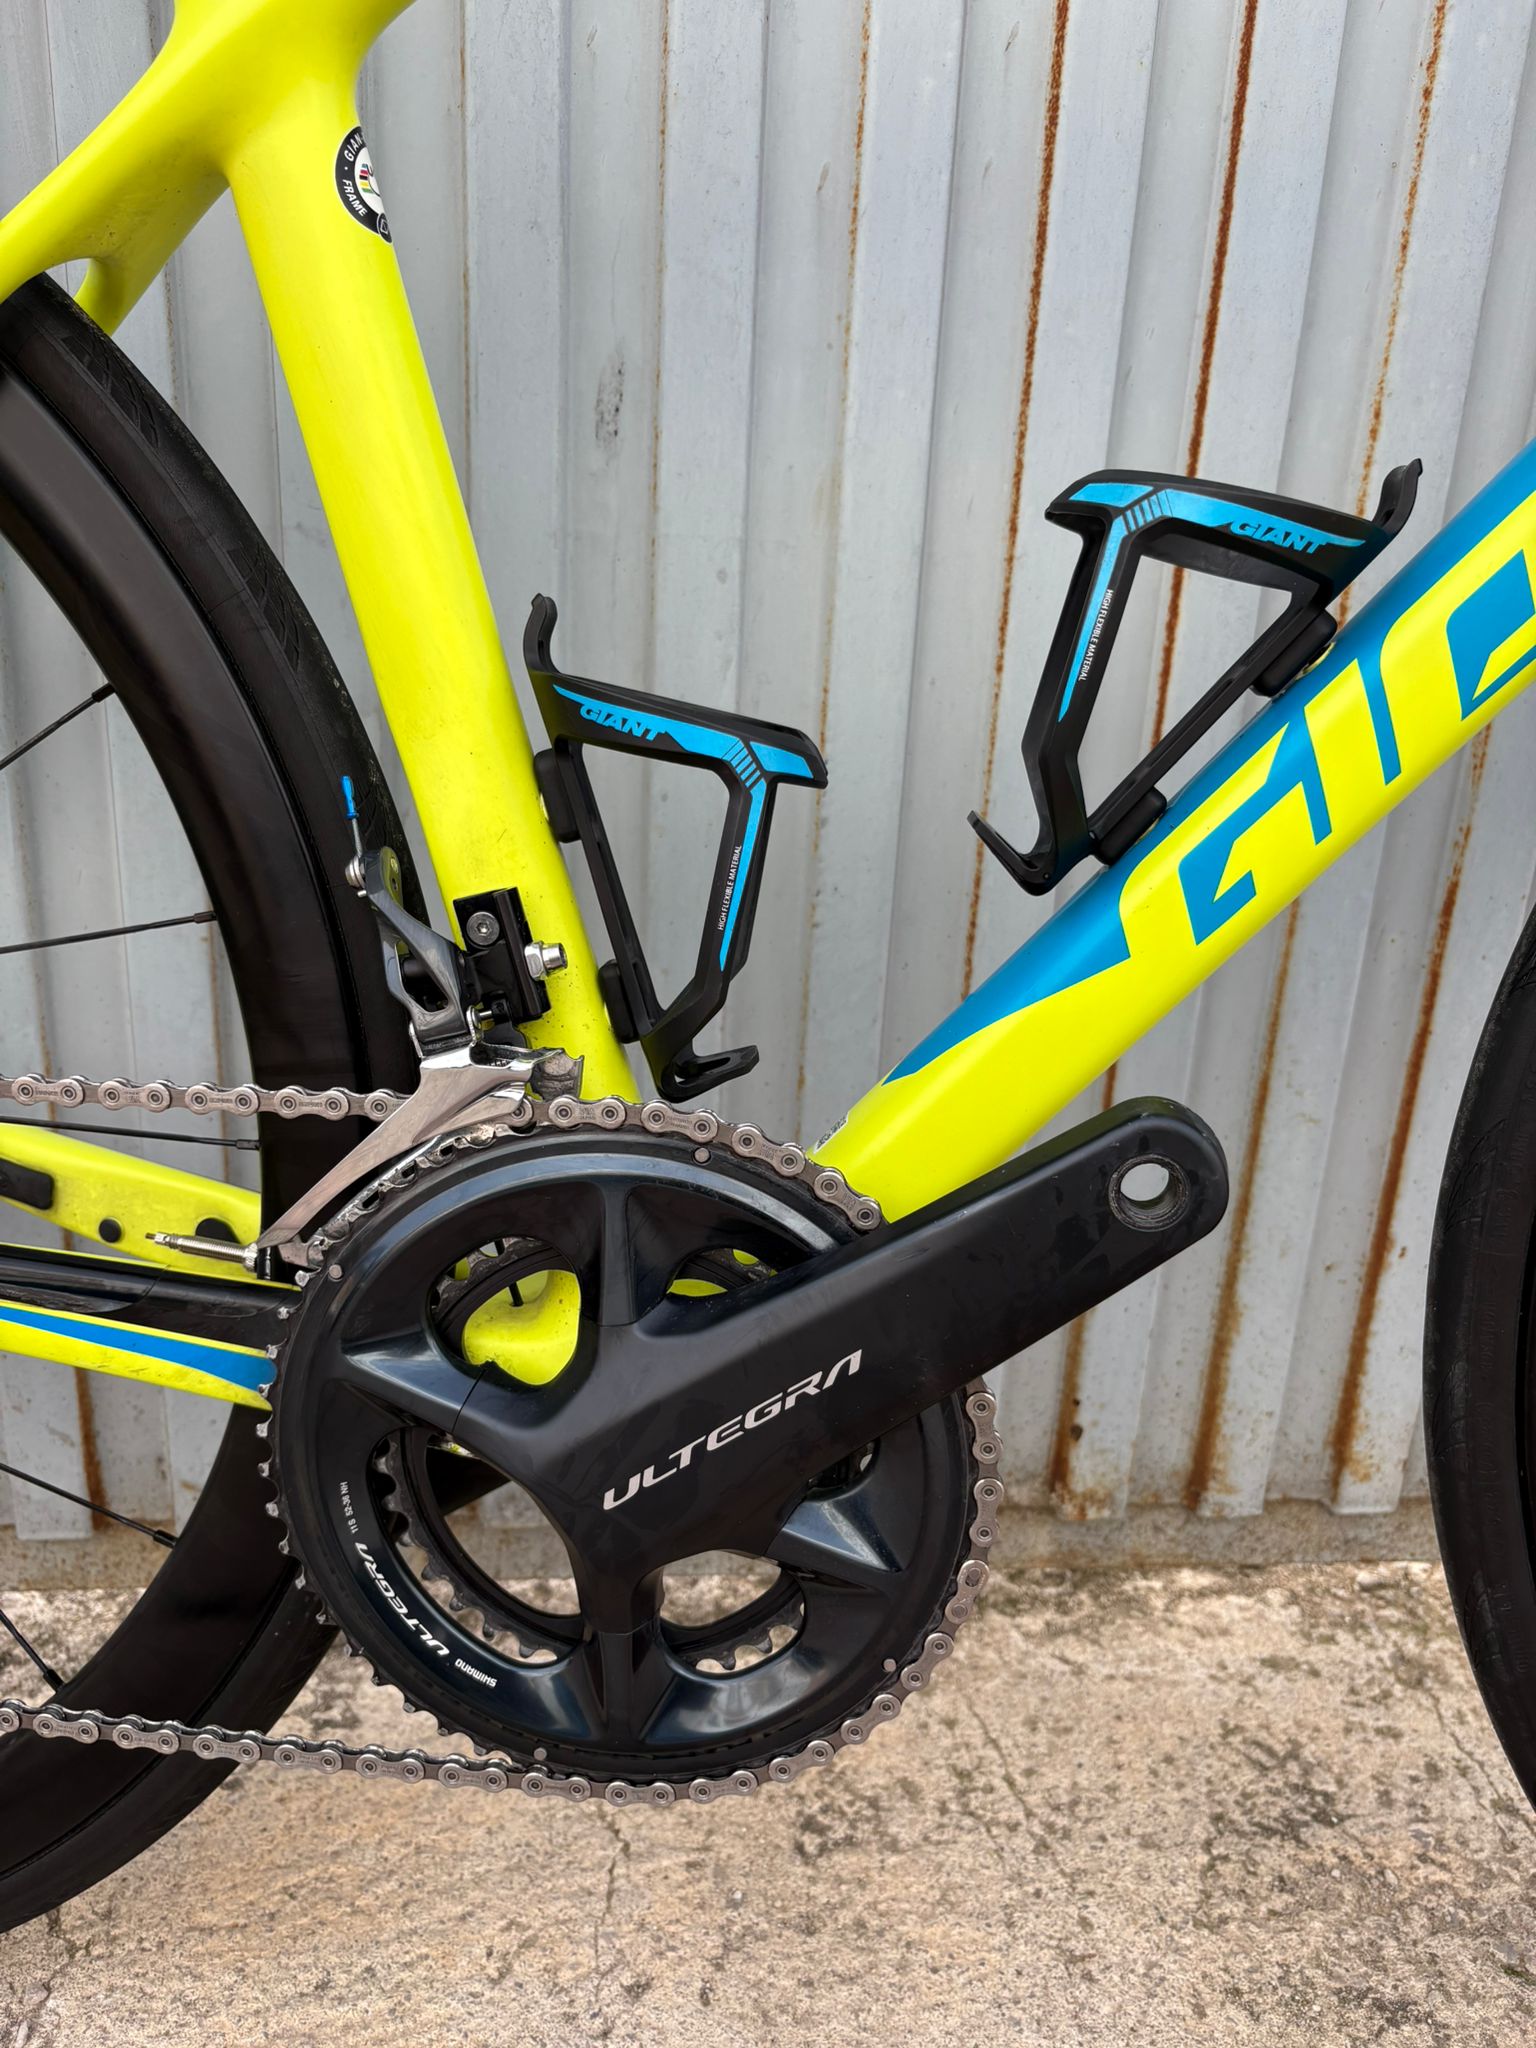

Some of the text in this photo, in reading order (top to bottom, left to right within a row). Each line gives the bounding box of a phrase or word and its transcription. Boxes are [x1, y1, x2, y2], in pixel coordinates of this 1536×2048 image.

[342, 179, 368, 217] FRAME
[1230, 519, 1327, 554] GIANT
[1078, 589, 1113, 681] HIGH FLEXIBLE MATERIAL
[580, 703, 667, 741] GIANT
[718, 845, 742, 930] HIGH FLEXIBLE MATERIAL
[603, 1349, 863, 1511] ULTEGRA
[341, 1494, 354, 1517] 52-36
[355, 1541, 450, 1656] ULTEGRA
[454, 1658, 498, 1688] SHIMANO
